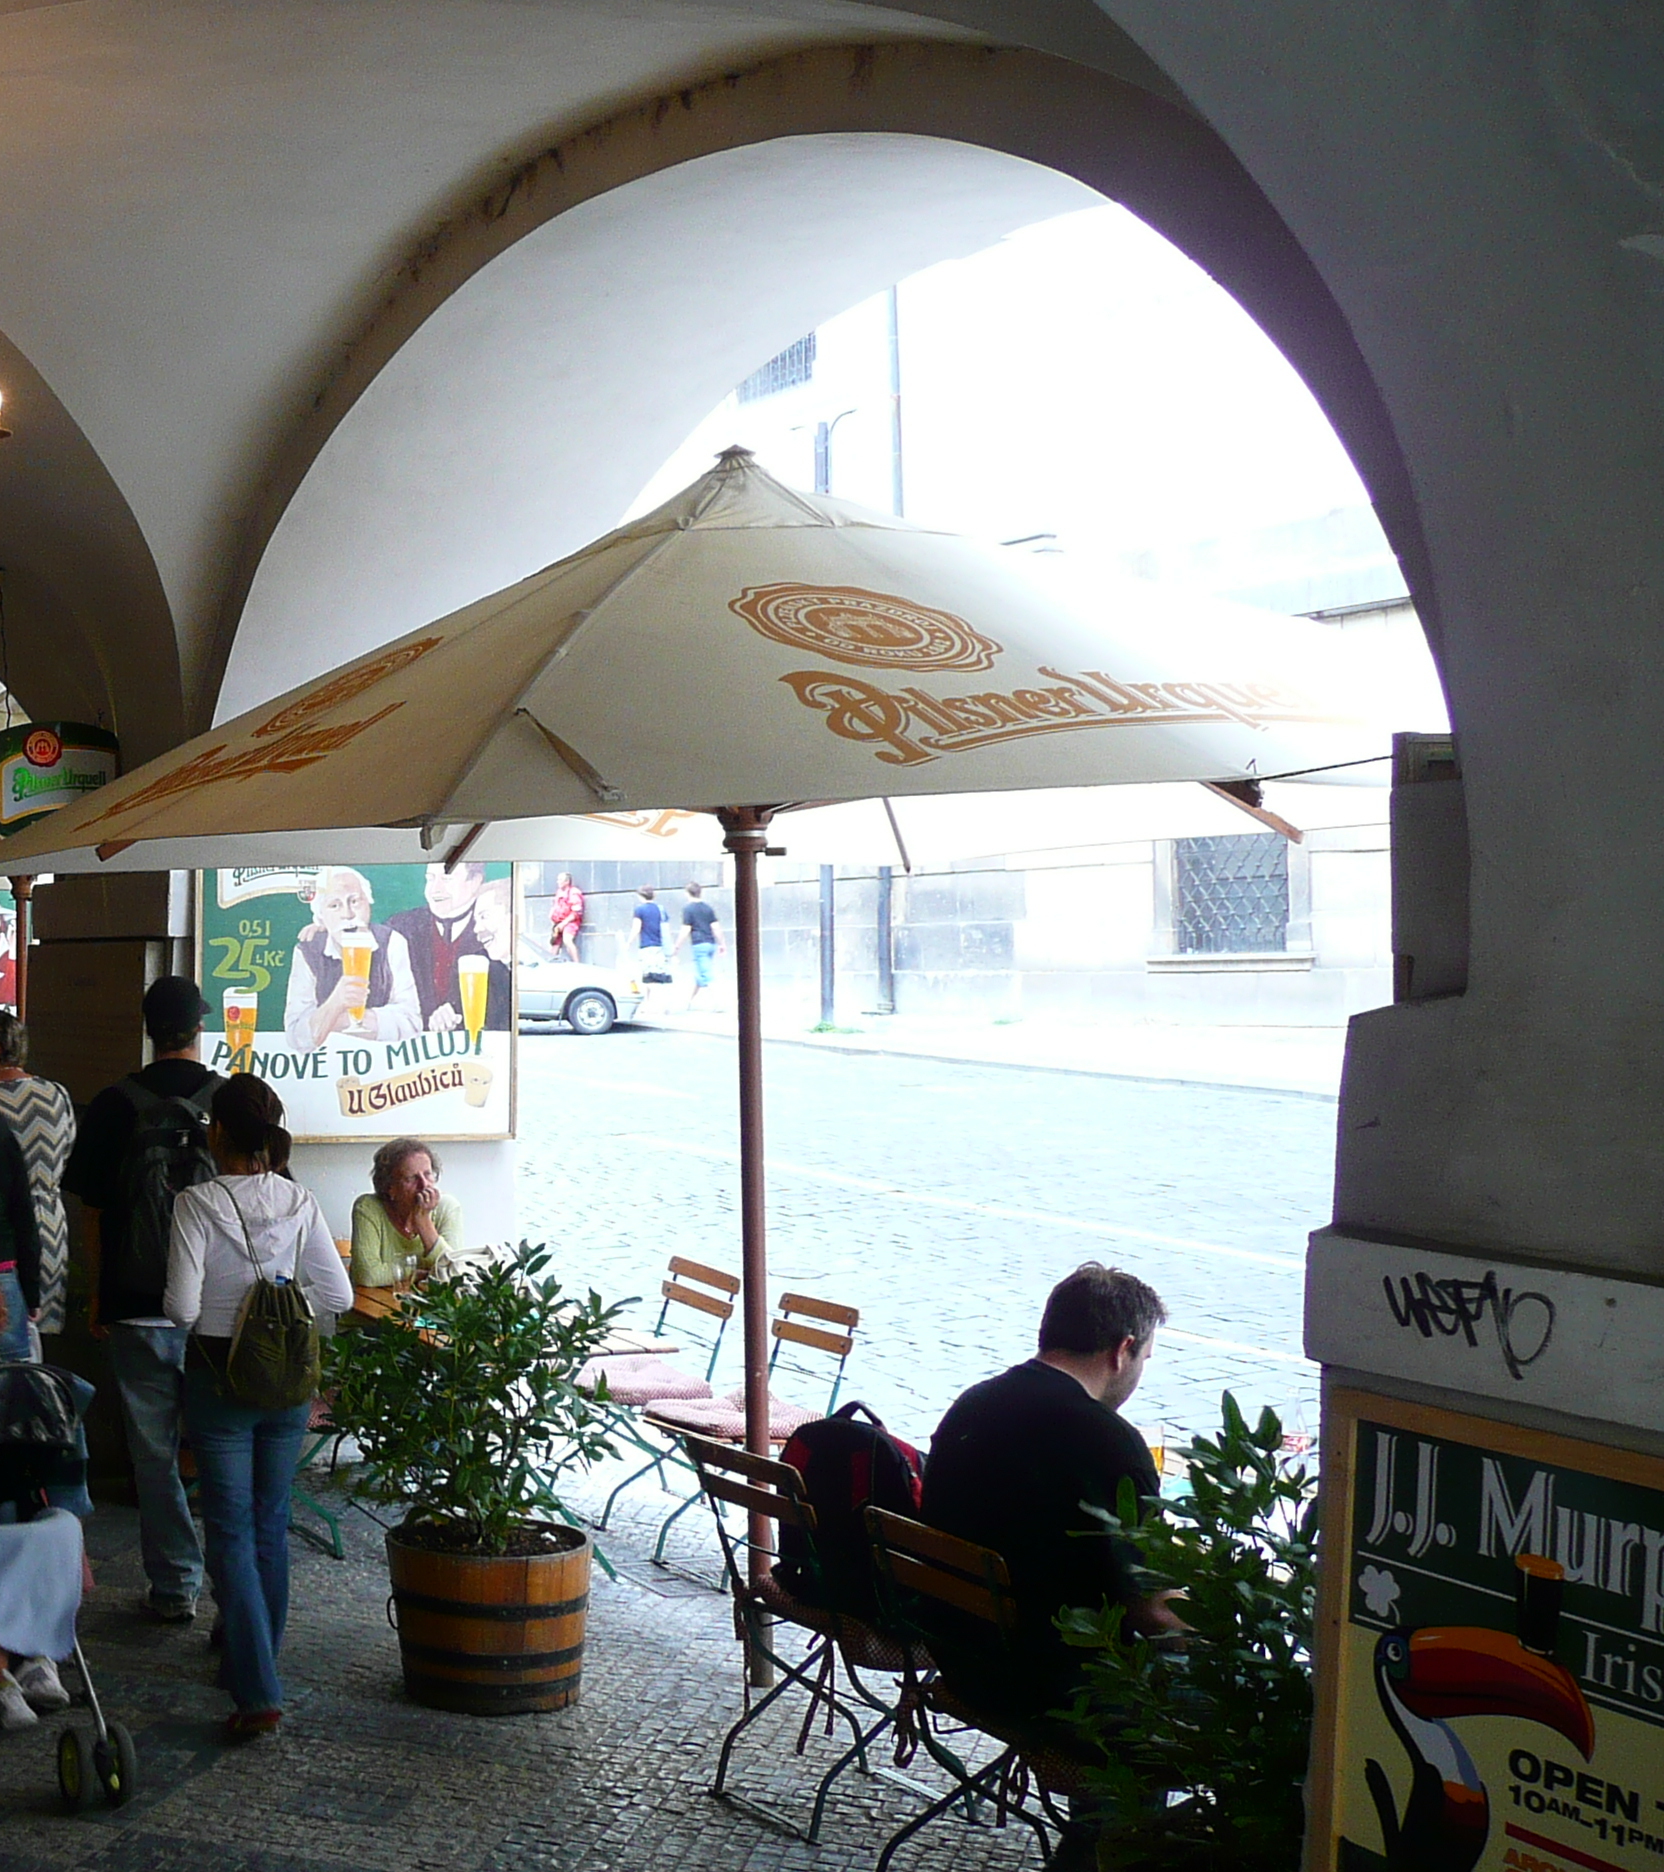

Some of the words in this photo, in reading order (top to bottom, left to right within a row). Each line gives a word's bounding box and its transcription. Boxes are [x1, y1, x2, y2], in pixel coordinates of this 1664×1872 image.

[778, 670, 1083, 767] Pilsner
[1036, 664, 1321, 732] Urque
[12, 766, 60, 802] Pilsner
[238, 919, 263, 937] 0,5
[211, 1040, 328, 1080] PÁNOVÉ
[336, 1049, 372, 1076] TO
[348, 1089, 367, 1114] U
[1365, 1431, 1457, 1559] J.J.
[1508, 1748, 1640, 1824] OPEN
